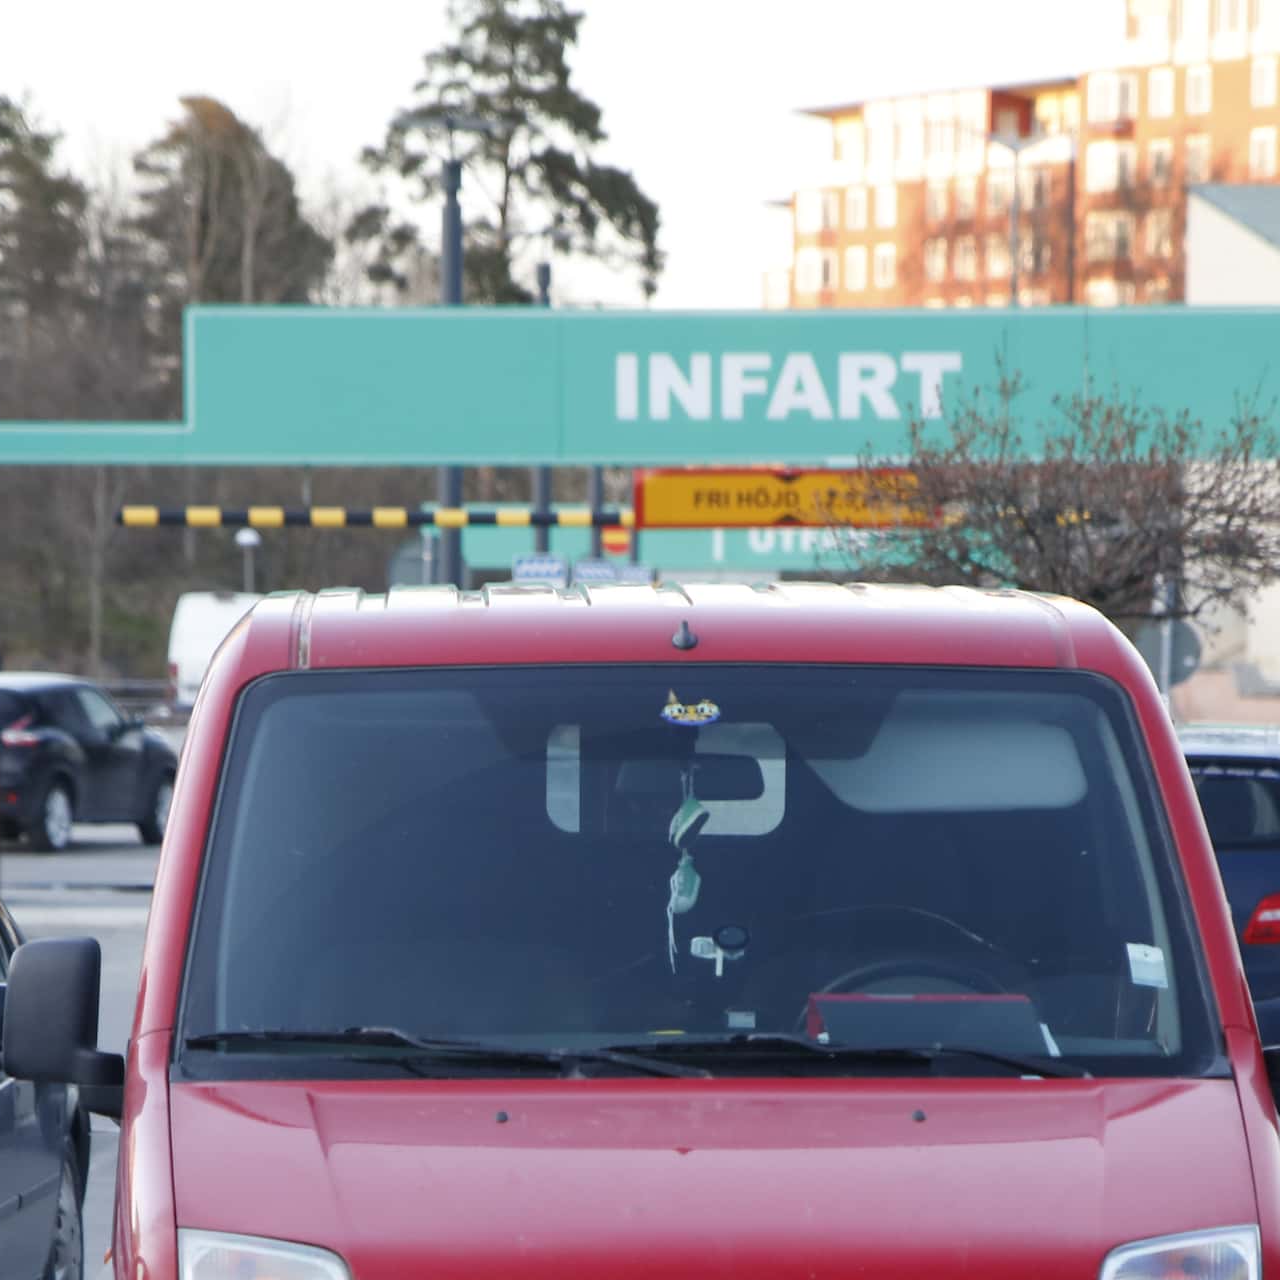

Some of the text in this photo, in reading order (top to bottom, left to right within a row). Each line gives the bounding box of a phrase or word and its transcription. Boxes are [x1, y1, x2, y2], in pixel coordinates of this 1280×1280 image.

[615, 352, 963, 421] INFART
[693, 489, 730, 509] FRI
[736, 486, 800, 509] HÖJD
